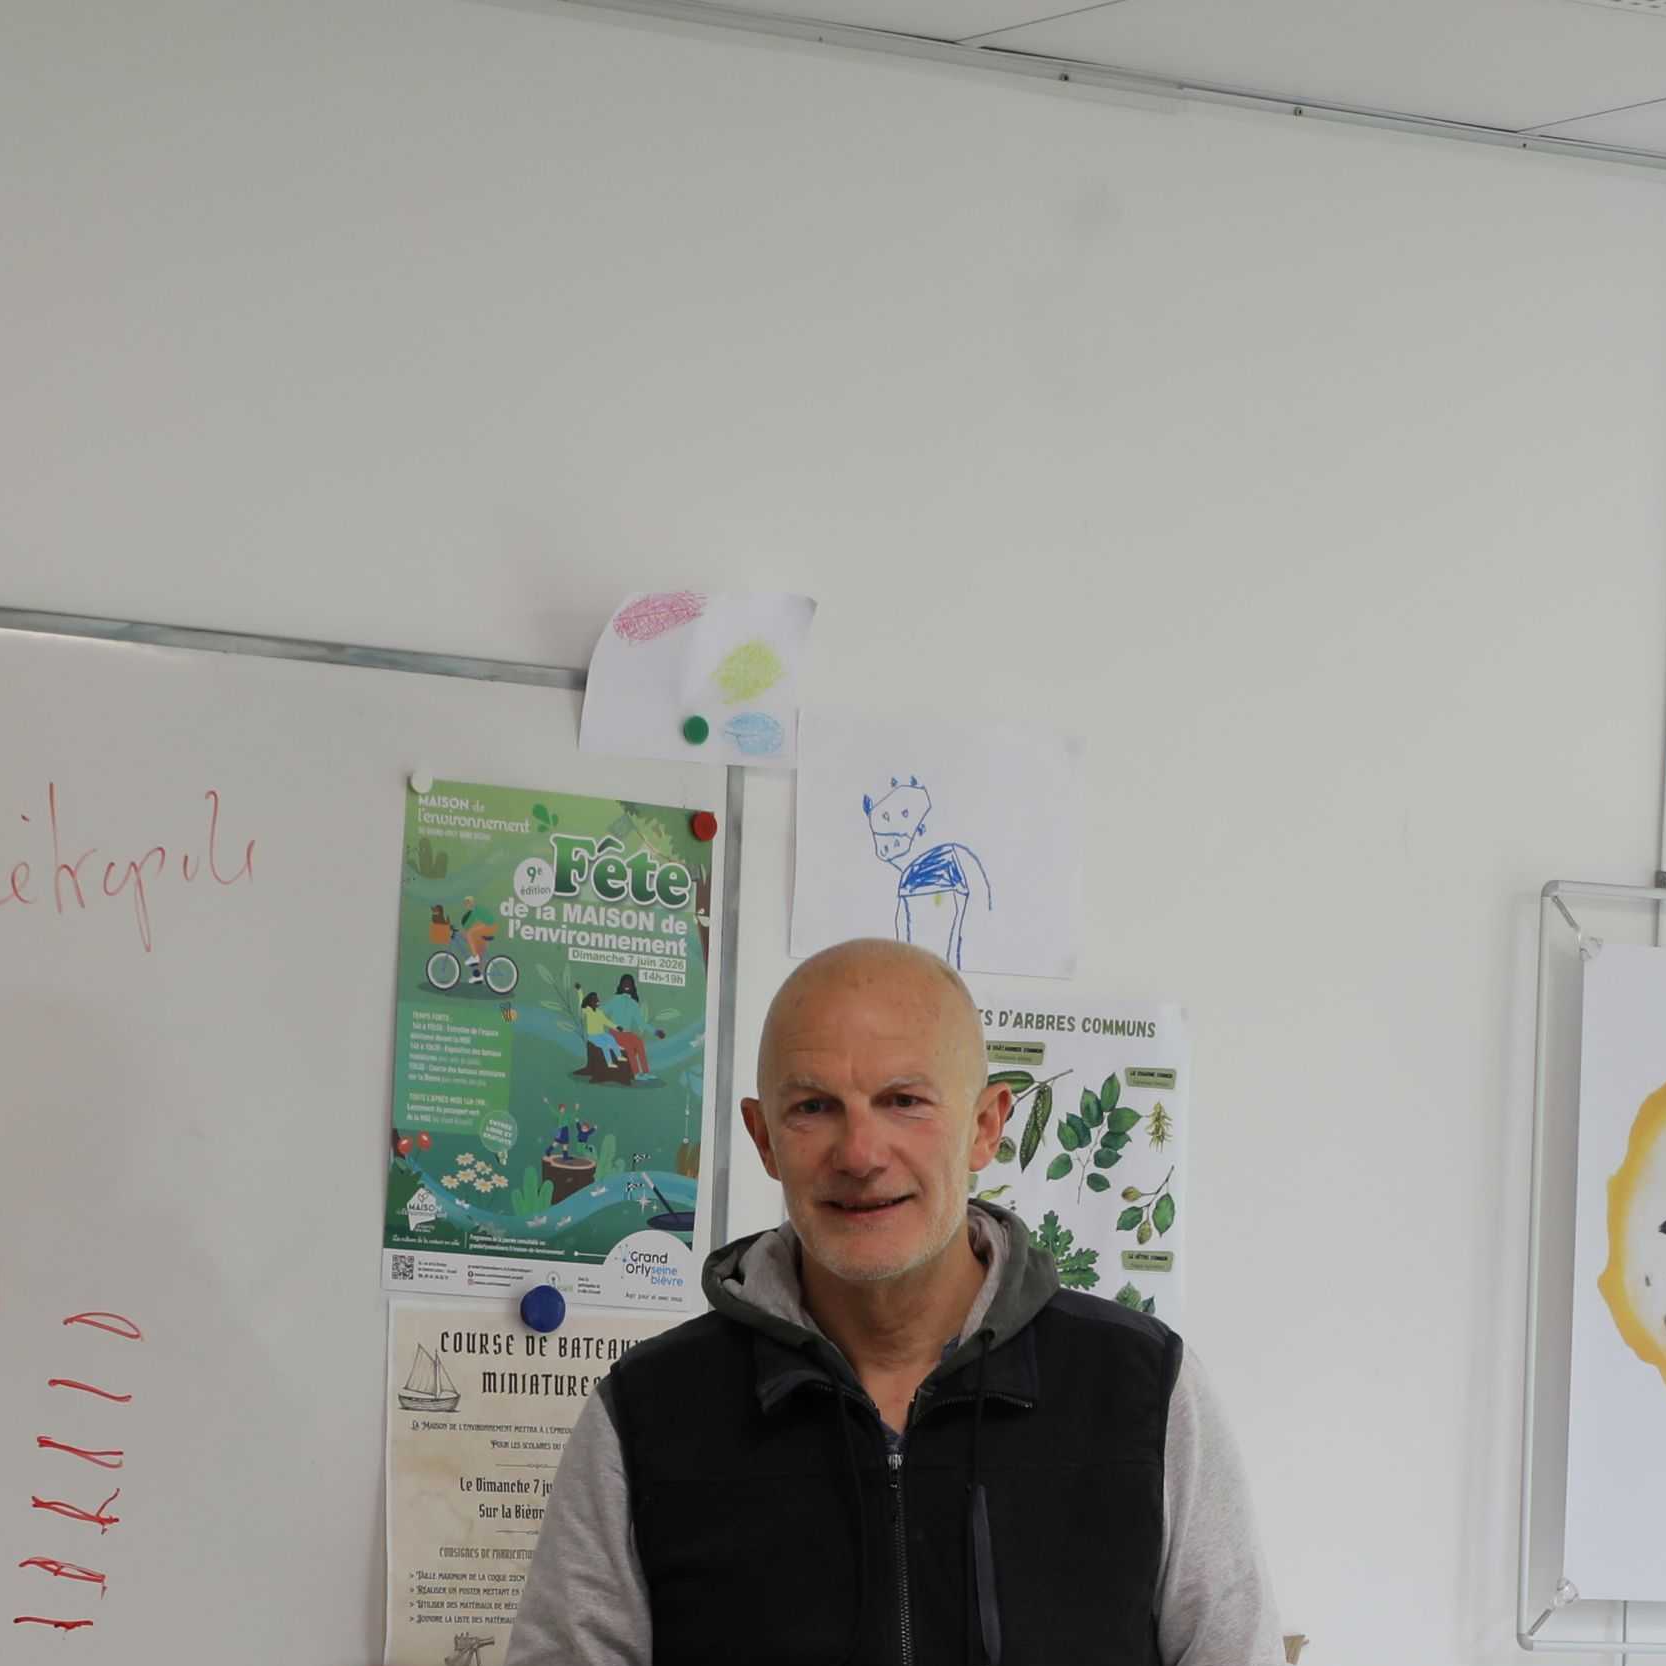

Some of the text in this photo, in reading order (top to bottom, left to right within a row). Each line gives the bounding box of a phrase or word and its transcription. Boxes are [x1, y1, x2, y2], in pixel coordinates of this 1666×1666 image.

[419, 795, 469, 810] MAISON
[418, 808, 530, 833] l'environnement
[550, 833, 692, 908] Fête
[520, 885, 551, 896] édition
[500, 897, 687, 935] de la MAISON de
[508, 919, 687, 957] l'environnement
[572, 949, 684, 969] Dimanche 7 juin 2026
[643, 972, 683, 984] 14h-19h
[999, 1010, 1076, 1032] D'ARBRES
[1082, 1017, 1155, 1038] COMMUNS
[631, 1251, 668, 1264] Grand
[625, 1264, 677, 1277] Orly seine
[651, 1275, 684, 1287] bièvre
[441, 1331, 644, 1360] COURSE DE BATEAU
[460, 1477, 473, 1491] Le
[476, 1477, 530, 1494] Dimanche
[533, 1479, 539, 1494] 7
[479, 1503, 544, 1520] Sur la Bièvr
